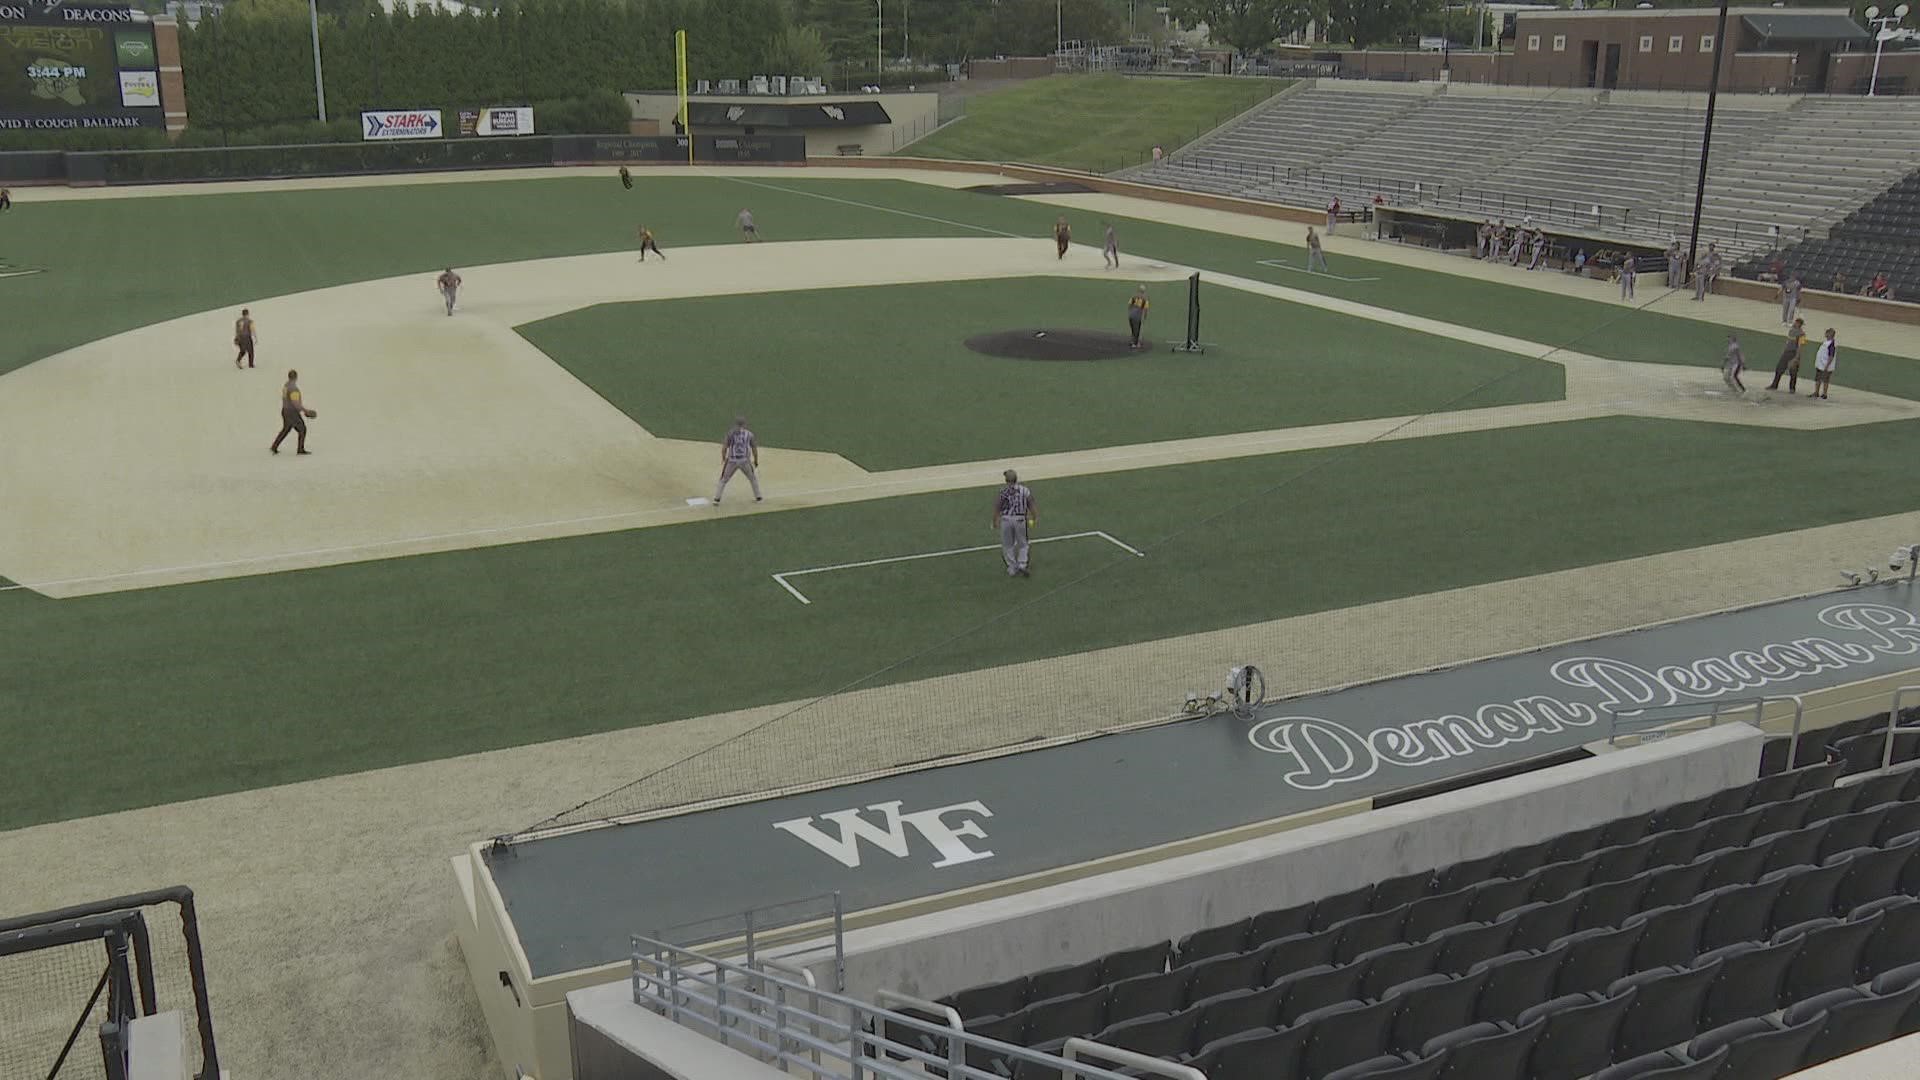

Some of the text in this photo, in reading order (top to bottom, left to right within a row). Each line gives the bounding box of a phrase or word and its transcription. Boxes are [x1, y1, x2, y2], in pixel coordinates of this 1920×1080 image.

[63, 8, 130, 21] DEACONS
[27, 66, 85, 78] 3:44 PM
[36, 118, 77, 127] COUCH
[83, 117, 140, 127] BALLPARK
[384, 114, 426, 128] STARK
[381, 127, 427, 137] EXTERMINATORS
[1248, 696, 1596, 790] Demon
[1550, 638, 1875, 717] Deacon
[771, 800, 995, 868] WF
